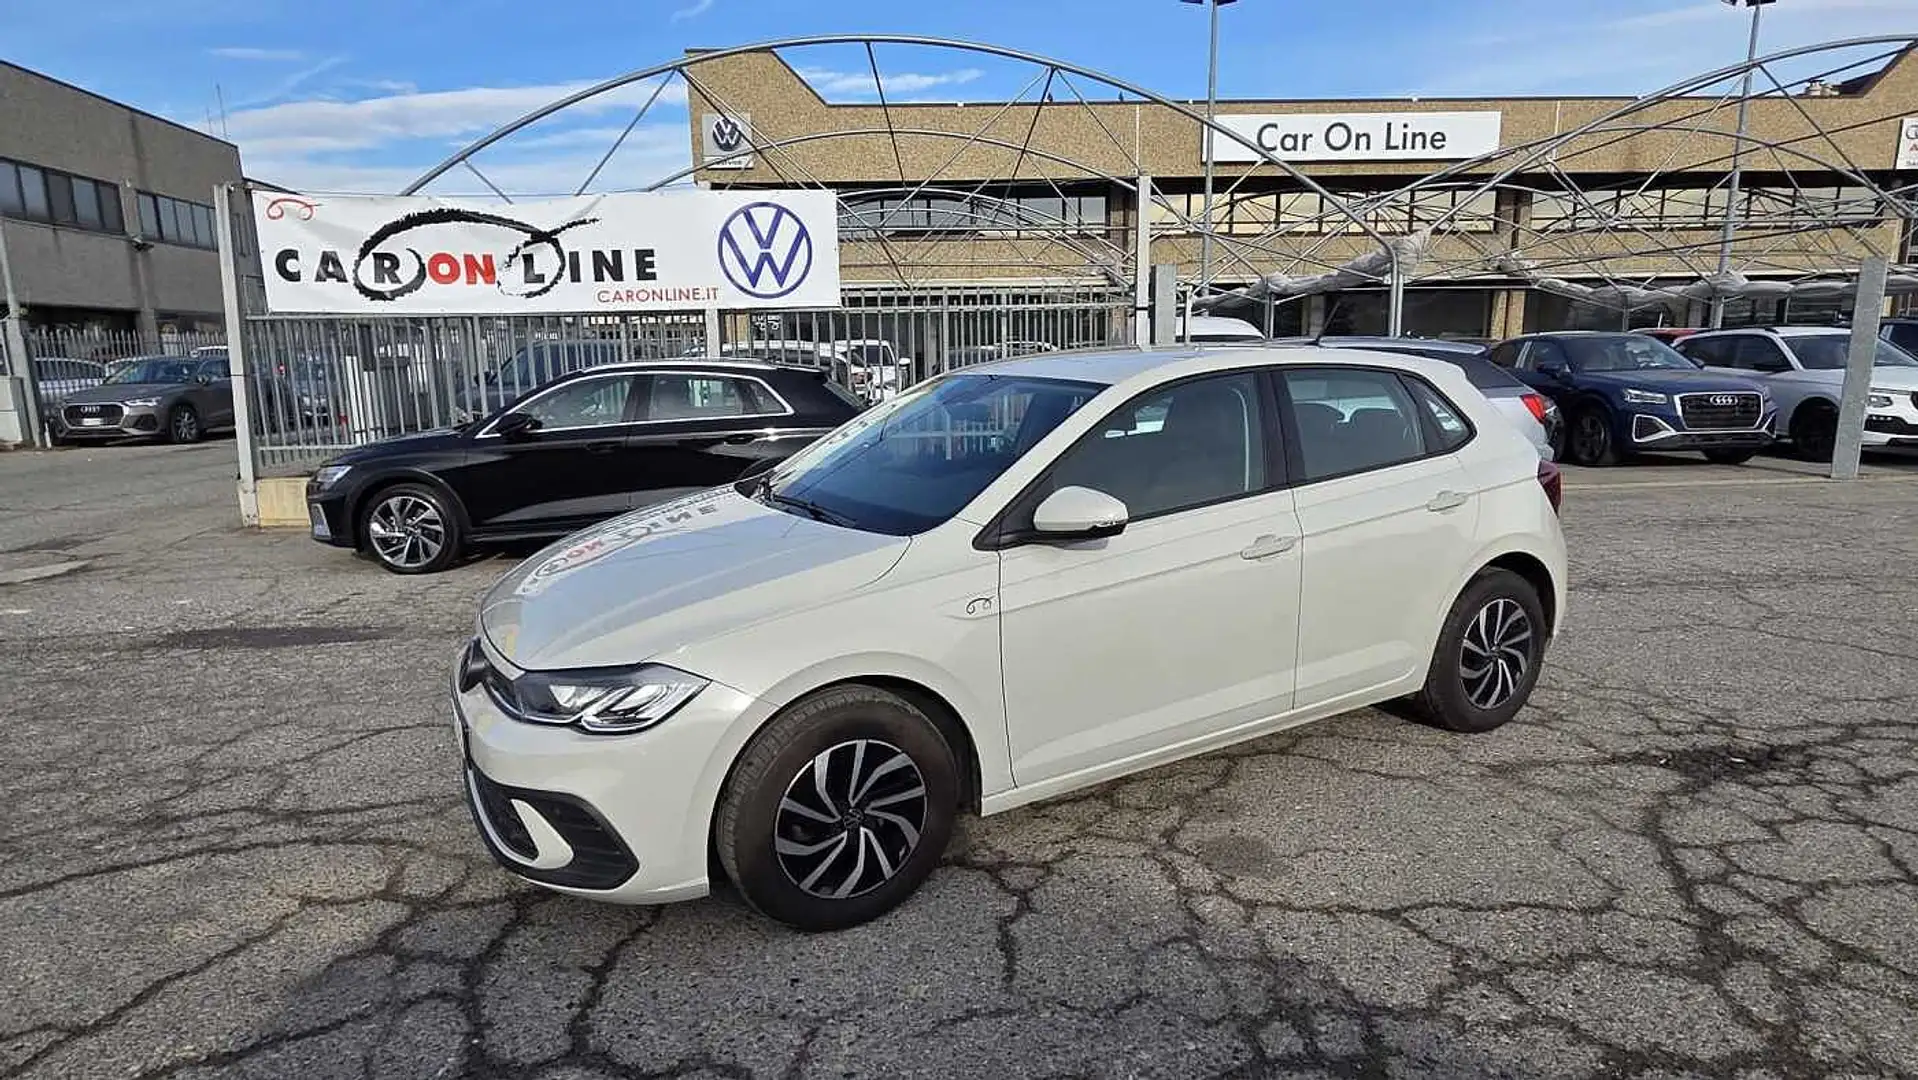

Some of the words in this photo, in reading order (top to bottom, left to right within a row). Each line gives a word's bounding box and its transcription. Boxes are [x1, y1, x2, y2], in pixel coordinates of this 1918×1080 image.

[1256, 122, 1313, 151] Car
[1324, 121, 1371, 150] On
[1385, 121, 1447, 150] Line
[597, 287, 719, 302] CARONLINE.IT
